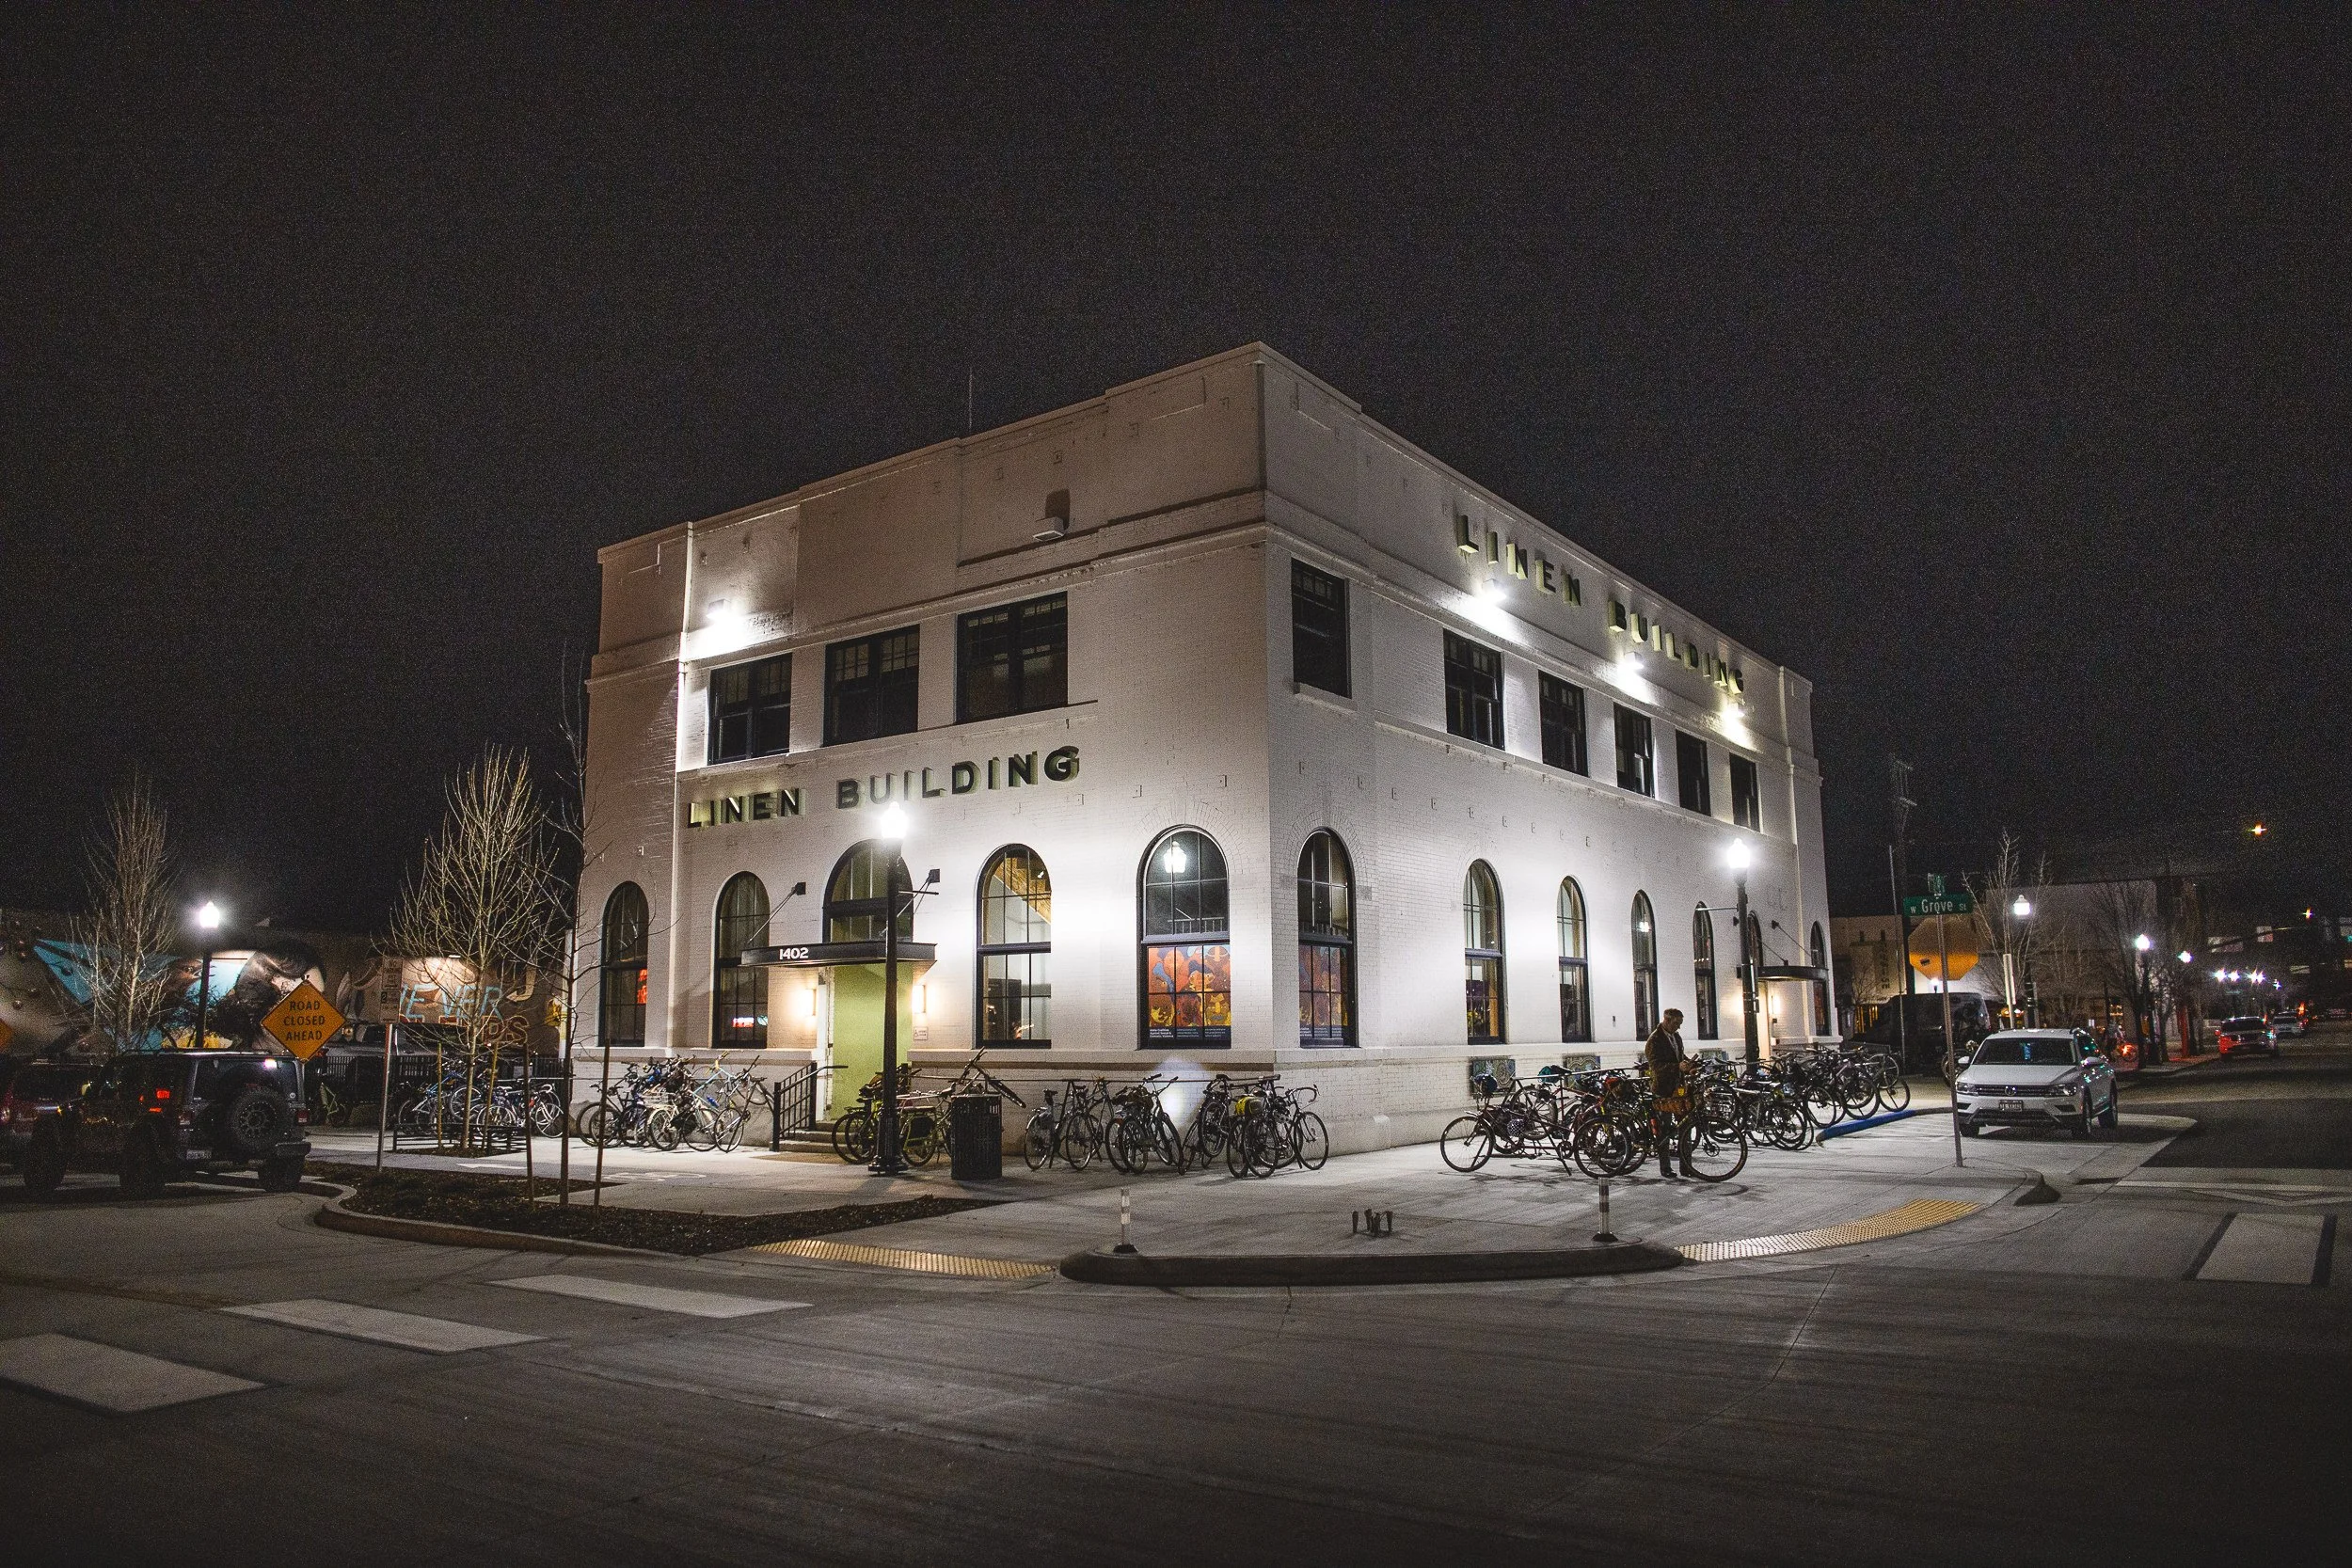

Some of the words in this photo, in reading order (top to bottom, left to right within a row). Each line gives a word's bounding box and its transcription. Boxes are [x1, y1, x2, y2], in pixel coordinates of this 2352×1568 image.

[1455, 515, 1581, 607] LINEN
[1608, 600, 1743, 694] BUILDING
[688, 788, 806, 829] LINEN
[836, 745, 1080, 809] BUILDING
[1921, 898, 1953, 913] Grove
[779, 946, 809, 959] 1402
[289, 1001, 321, 1010] ROAD
[283, 1016, 326, 1026] CLOSED
[286, 1031, 323, 1041] AHEAD
